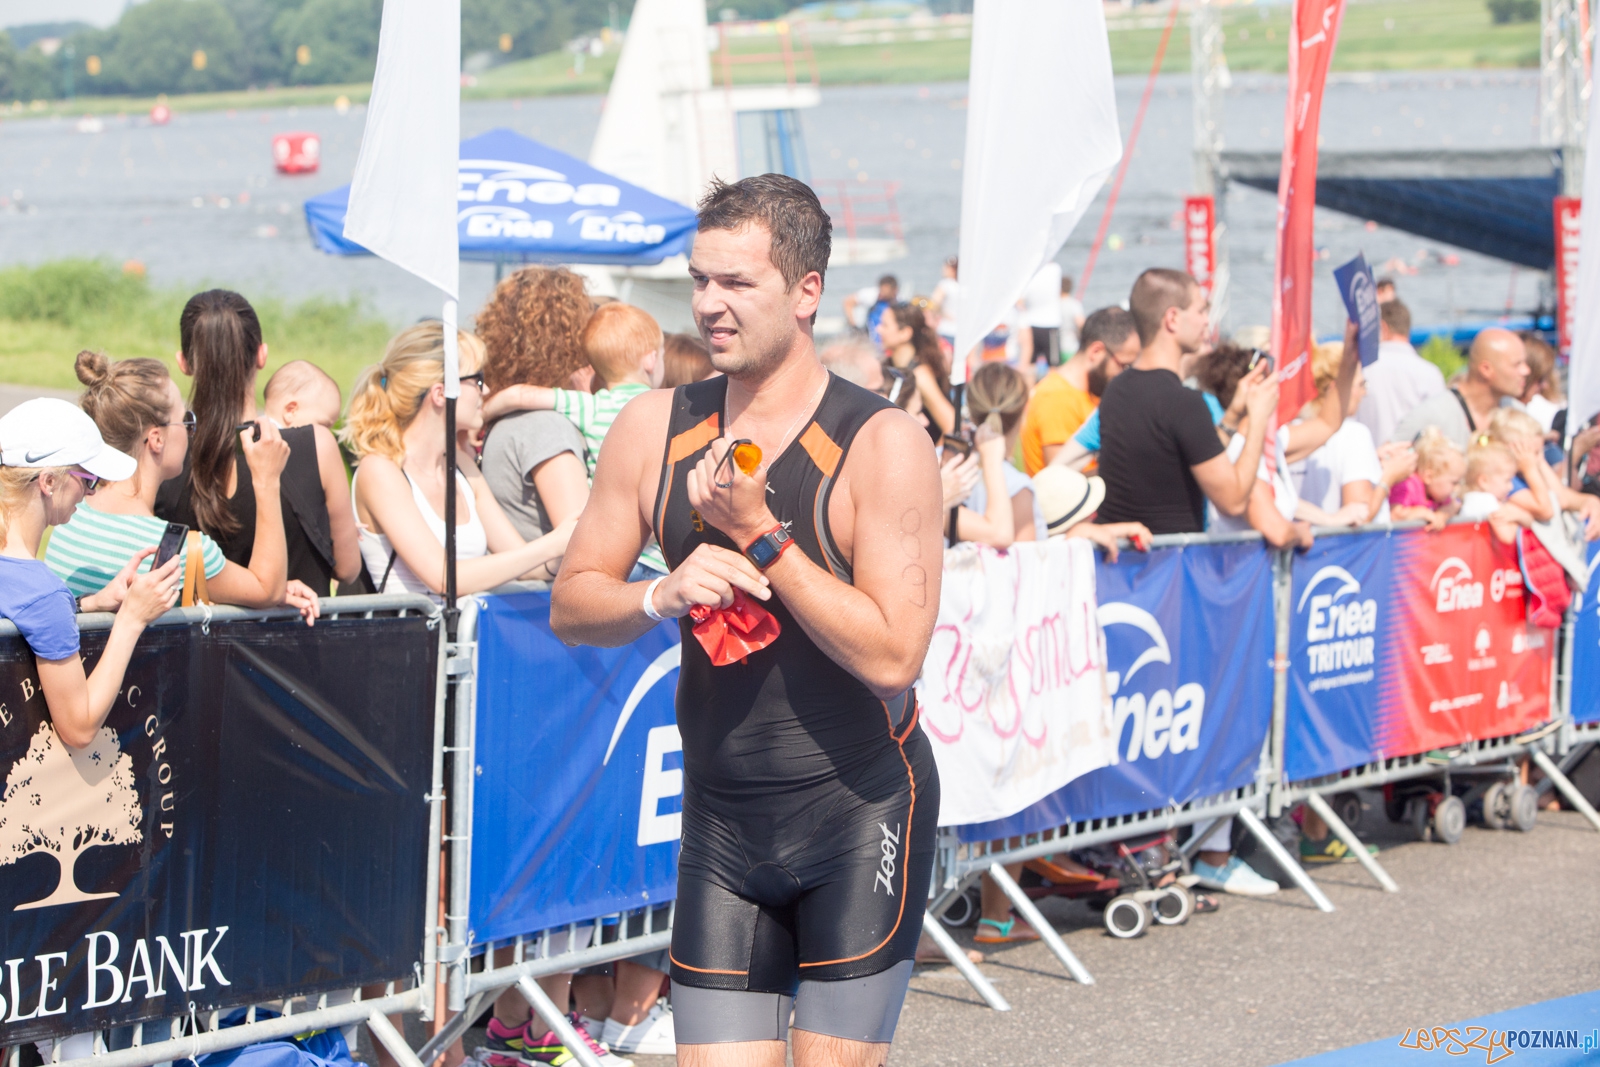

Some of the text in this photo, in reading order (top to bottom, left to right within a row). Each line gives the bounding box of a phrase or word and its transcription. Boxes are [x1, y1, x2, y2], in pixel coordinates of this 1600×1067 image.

[466, 214, 554, 239] Enea
[579, 215, 667, 245] Enea
[1307, 594, 1377, 643] Enea
[1307, 636, 1376, 674] TRITOUR
[145, 714, 174, 839] GROUP
[0, 925, 231, 1024] LE BANK
